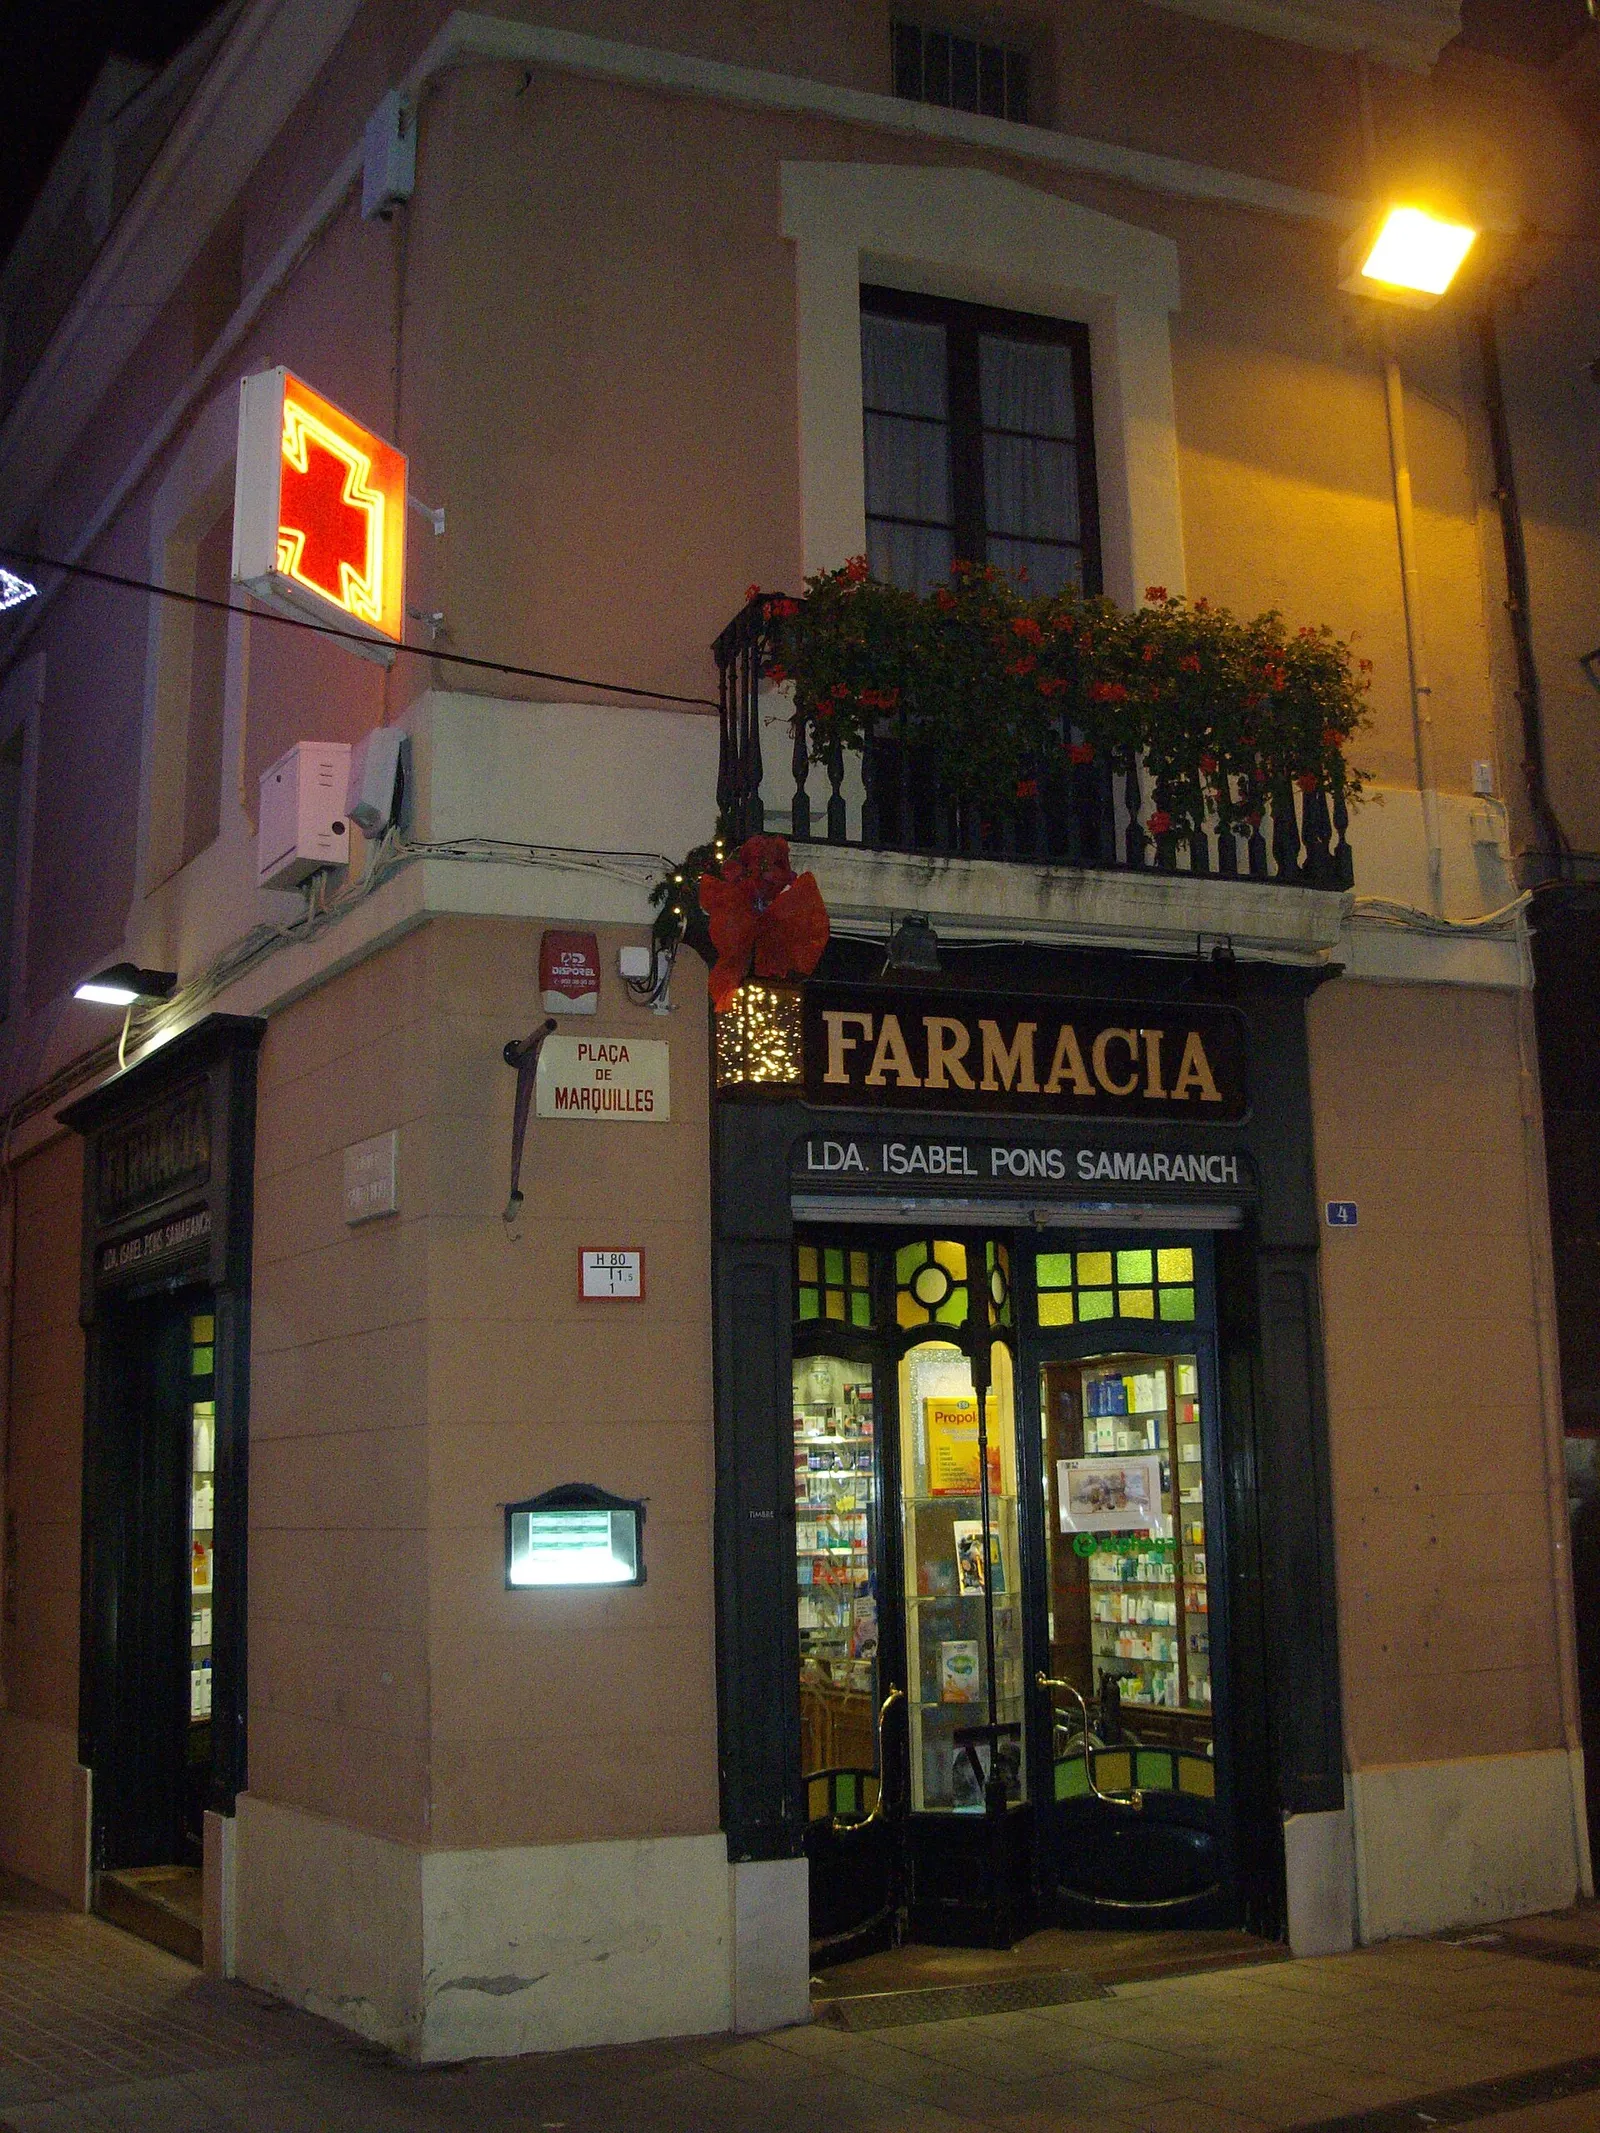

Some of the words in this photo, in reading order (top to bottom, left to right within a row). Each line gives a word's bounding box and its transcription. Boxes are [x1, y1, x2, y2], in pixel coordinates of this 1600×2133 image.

[577, 1043, 630, 1065] PLAÇA
[821, 1010, 1223, 1102] FARMACIA
[595, 1069, 612, 1081] DE
[554, 1087, 654, 1114] MARQUILLES
[807, 1141, 869, 1172] LDA.
[882, 1143, 978, 1176] ISABEL
[991, 1147, 1065, 1180] PONS
[1077, 1150, 1238, 1184] SAMARANCH
[1336, 1205, 1348, 1222] 4
[596, 1253, 605, 1265] H
[610, 1253, 626, 1266] 80
[609, 1282, 614, 1294] 1
